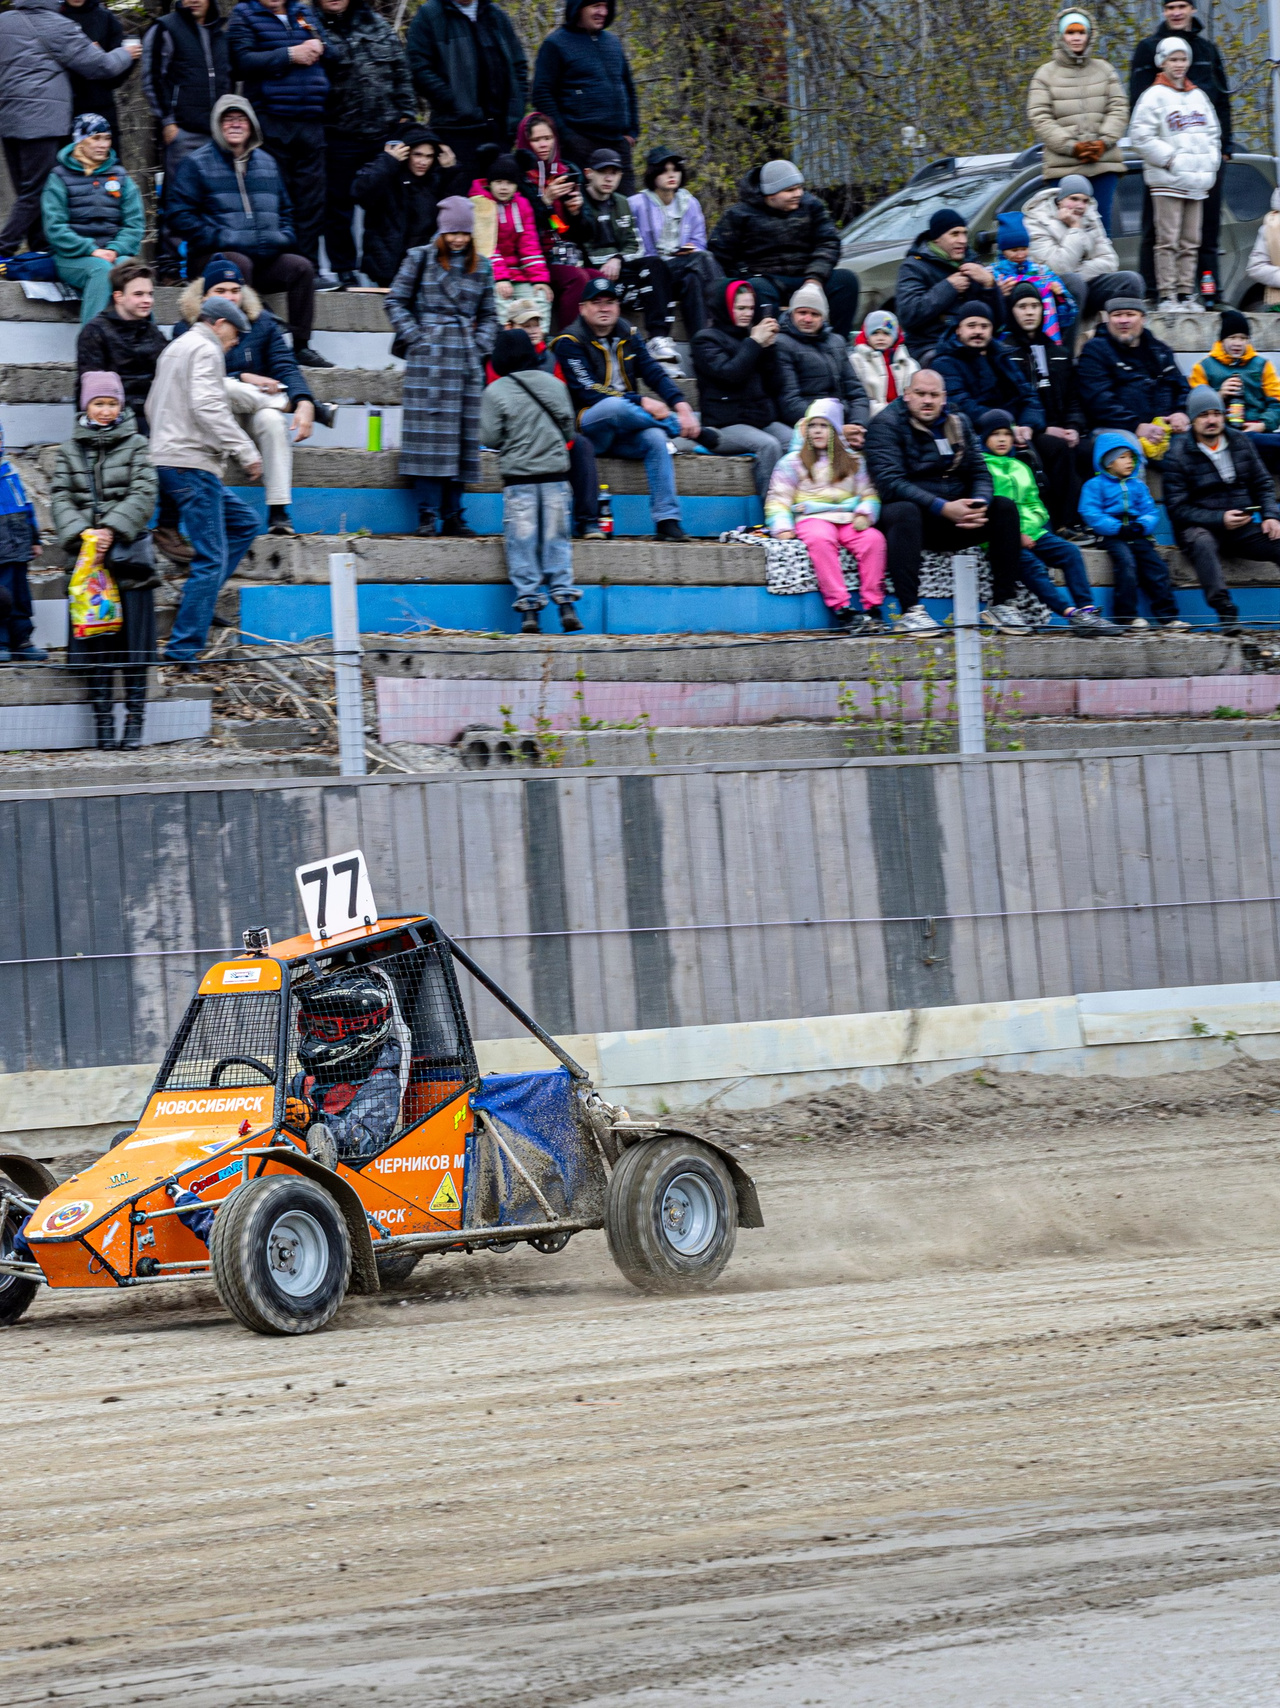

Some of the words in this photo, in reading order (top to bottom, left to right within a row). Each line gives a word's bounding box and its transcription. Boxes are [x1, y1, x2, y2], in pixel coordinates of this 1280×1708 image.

[301, 857, 359, 929] 77
[154, 1097, 264, 1118] НОВОСИБИРСК
[375, 1154, 450, 1174] ЧЕРНИКОВ
